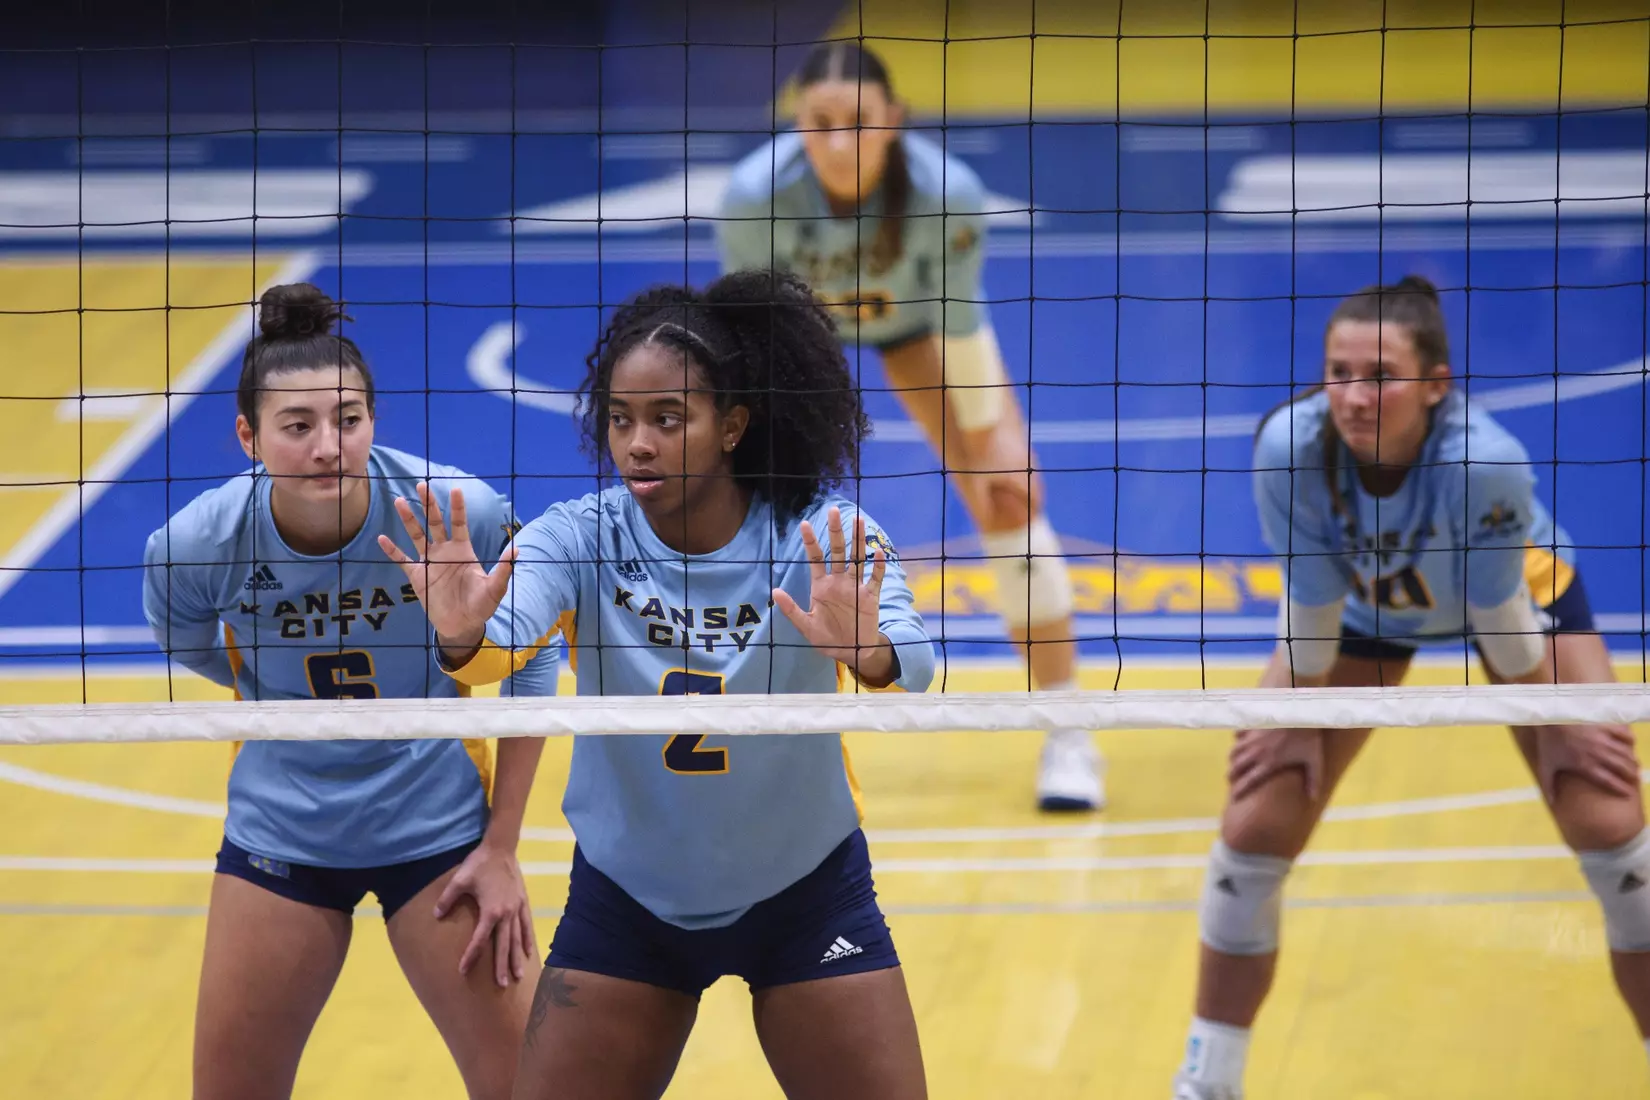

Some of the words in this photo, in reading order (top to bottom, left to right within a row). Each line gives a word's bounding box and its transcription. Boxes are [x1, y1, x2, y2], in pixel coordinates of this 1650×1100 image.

[280, 612, 388, 639] CITY
[614, 585, 775, 630] KANSA
[647, 622, 755, 653] CITY
[658, 667, 730, 775] 2
